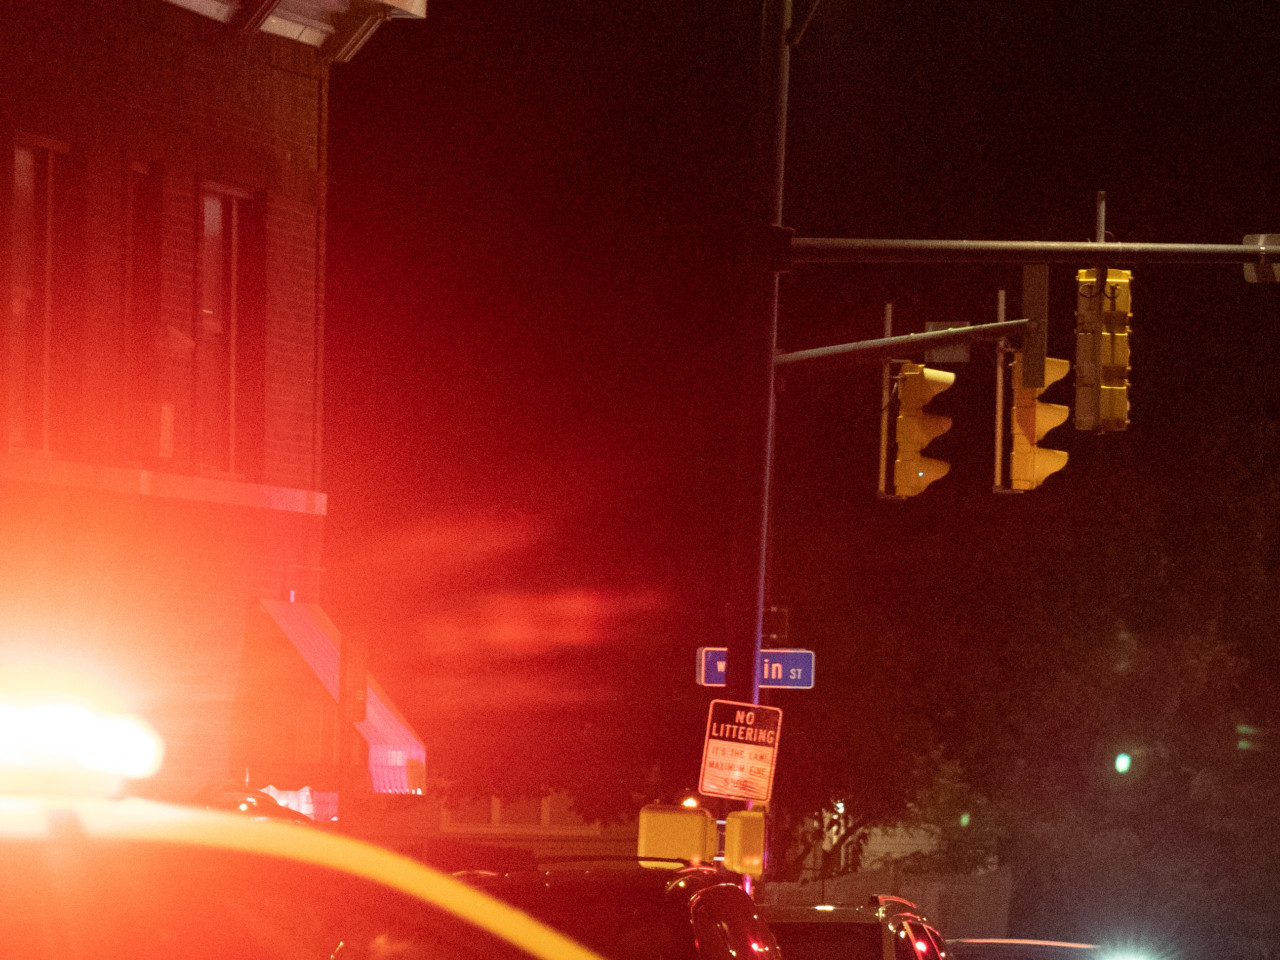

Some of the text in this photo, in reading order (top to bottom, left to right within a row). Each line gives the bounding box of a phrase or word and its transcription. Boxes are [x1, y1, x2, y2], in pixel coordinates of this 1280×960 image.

[789, 668, 803, 680] ST
[735, 709, 755, 726] NO
[711, 722, 776, 744] LITTERING
[708, 760, 745, 772] MAXIMM
